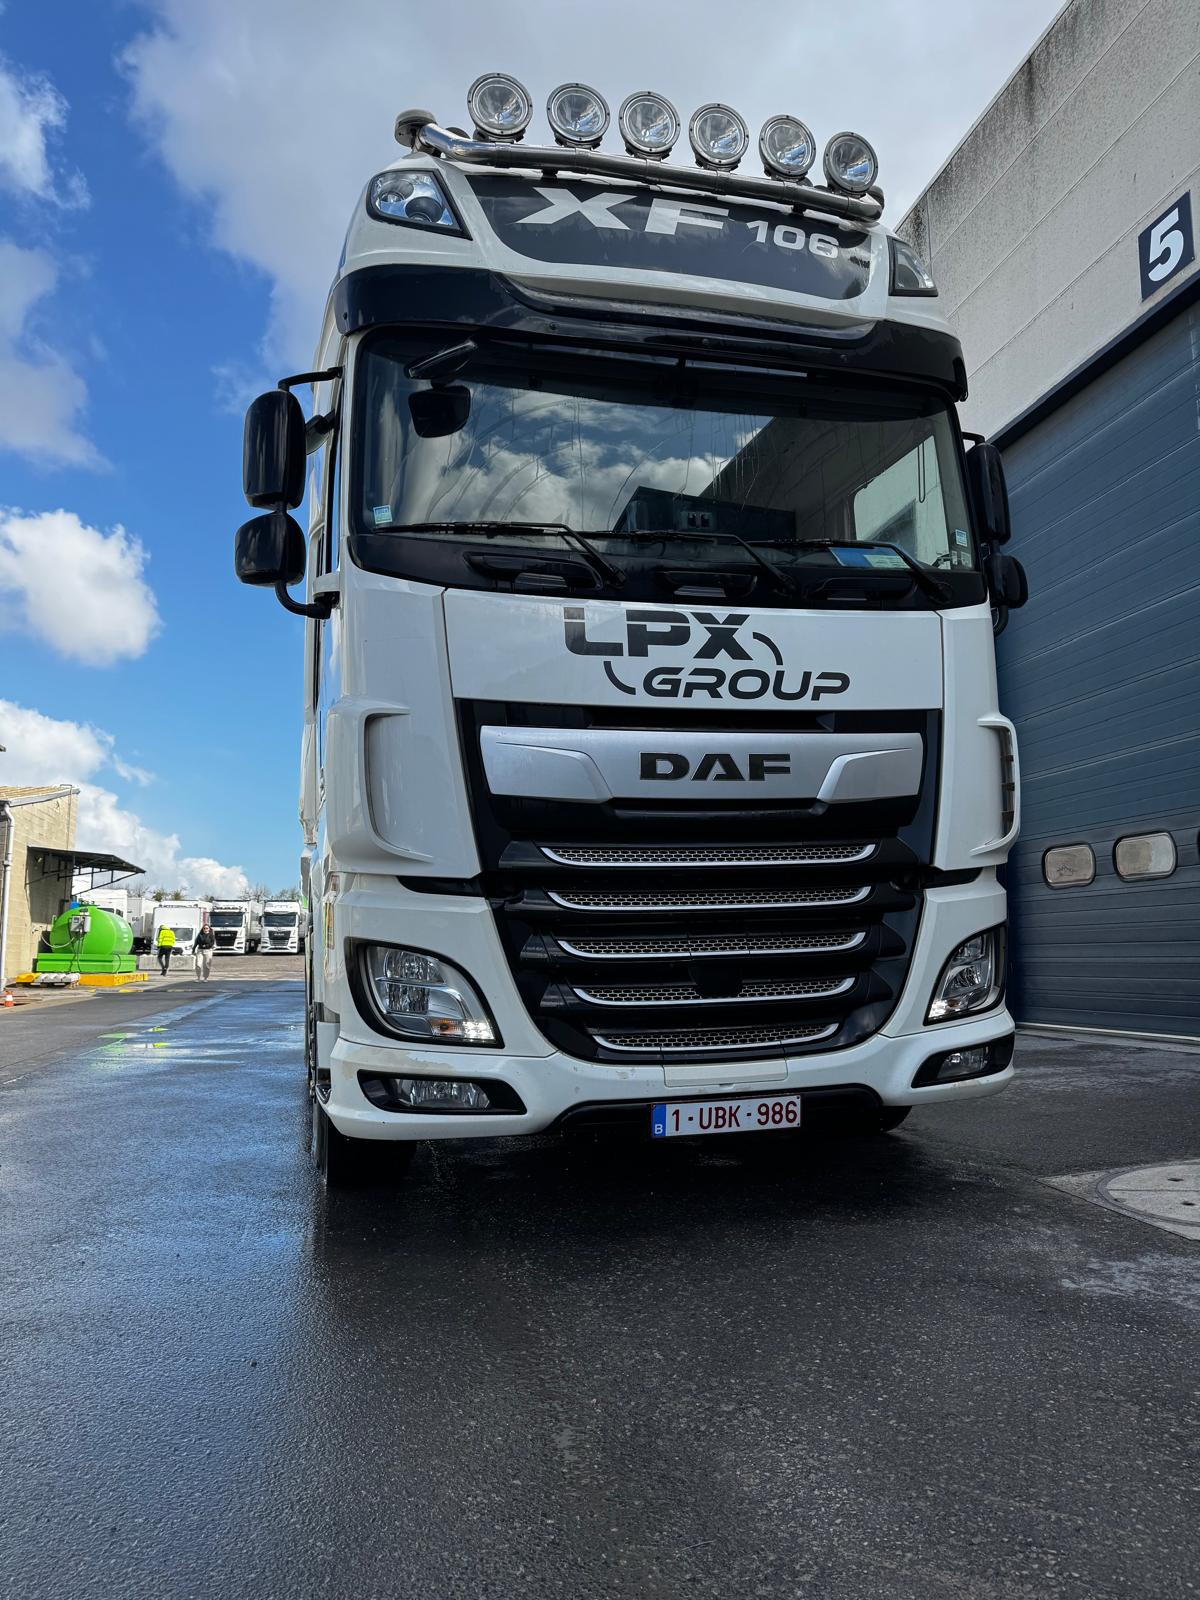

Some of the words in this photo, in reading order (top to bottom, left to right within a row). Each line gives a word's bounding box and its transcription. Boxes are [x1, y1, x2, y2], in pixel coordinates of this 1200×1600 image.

[514, 187, 729, 235] XF
[747, 220, 839, 259] 106
[1148, 207, 1184, 282] 5
[563, 606, 754, 661] LPX
[642, 667, 851, 701] GROUP
[639, 752, 791, 782] DAF
[654, 1123, 663, 1135] B
